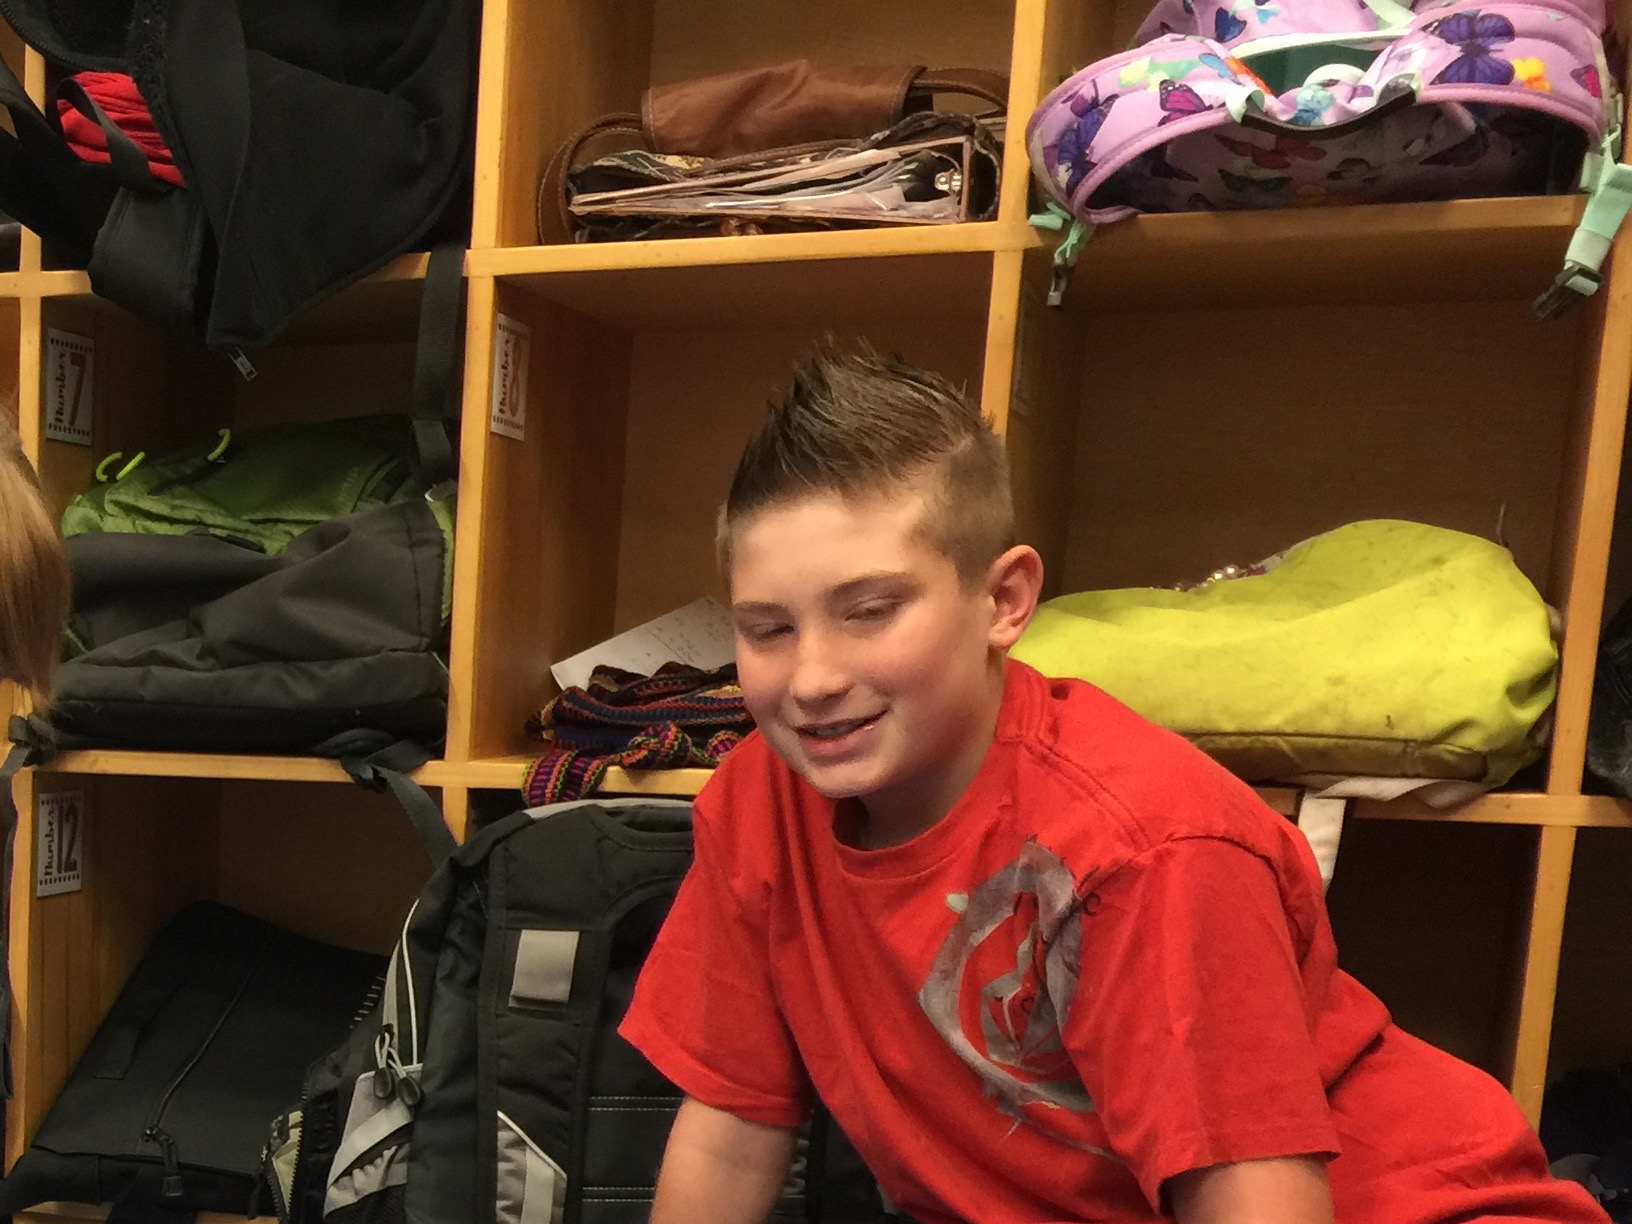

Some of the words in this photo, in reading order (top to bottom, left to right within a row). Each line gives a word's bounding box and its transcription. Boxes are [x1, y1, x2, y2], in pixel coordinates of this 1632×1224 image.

[69, 352, 87, 426] 7
[509, 338, 522, 417] 8
[57, 803, 79, 875] 12
